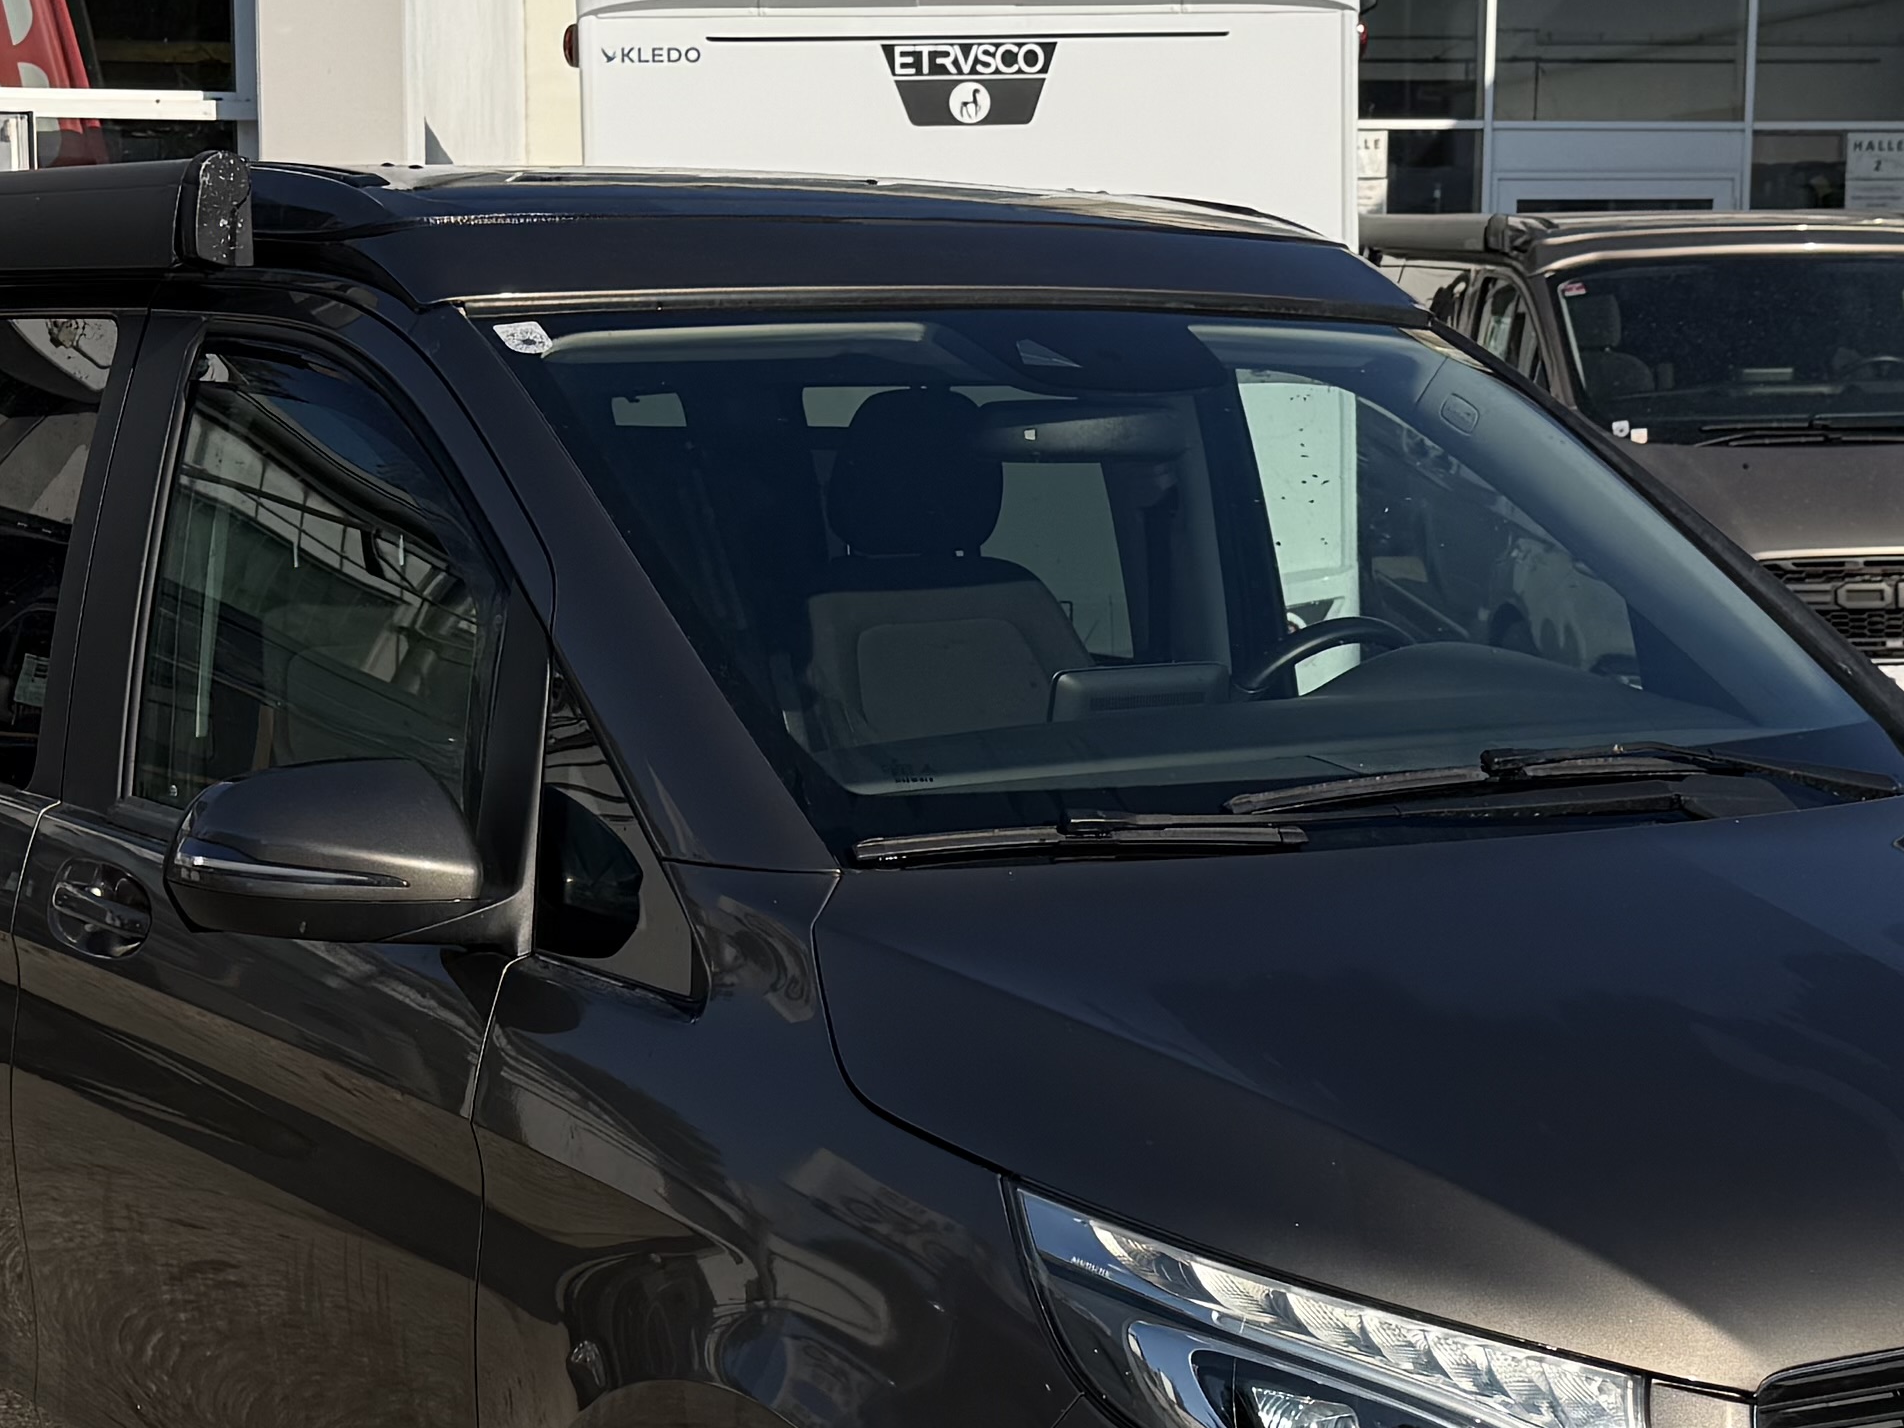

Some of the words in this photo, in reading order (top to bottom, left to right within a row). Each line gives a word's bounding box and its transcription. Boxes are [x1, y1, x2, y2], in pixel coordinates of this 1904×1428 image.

[621, 46, 701, 64] KLEDO
[1853, 139, 1904, 152] HALLE
[1873, 159, 1882, 172] 2
